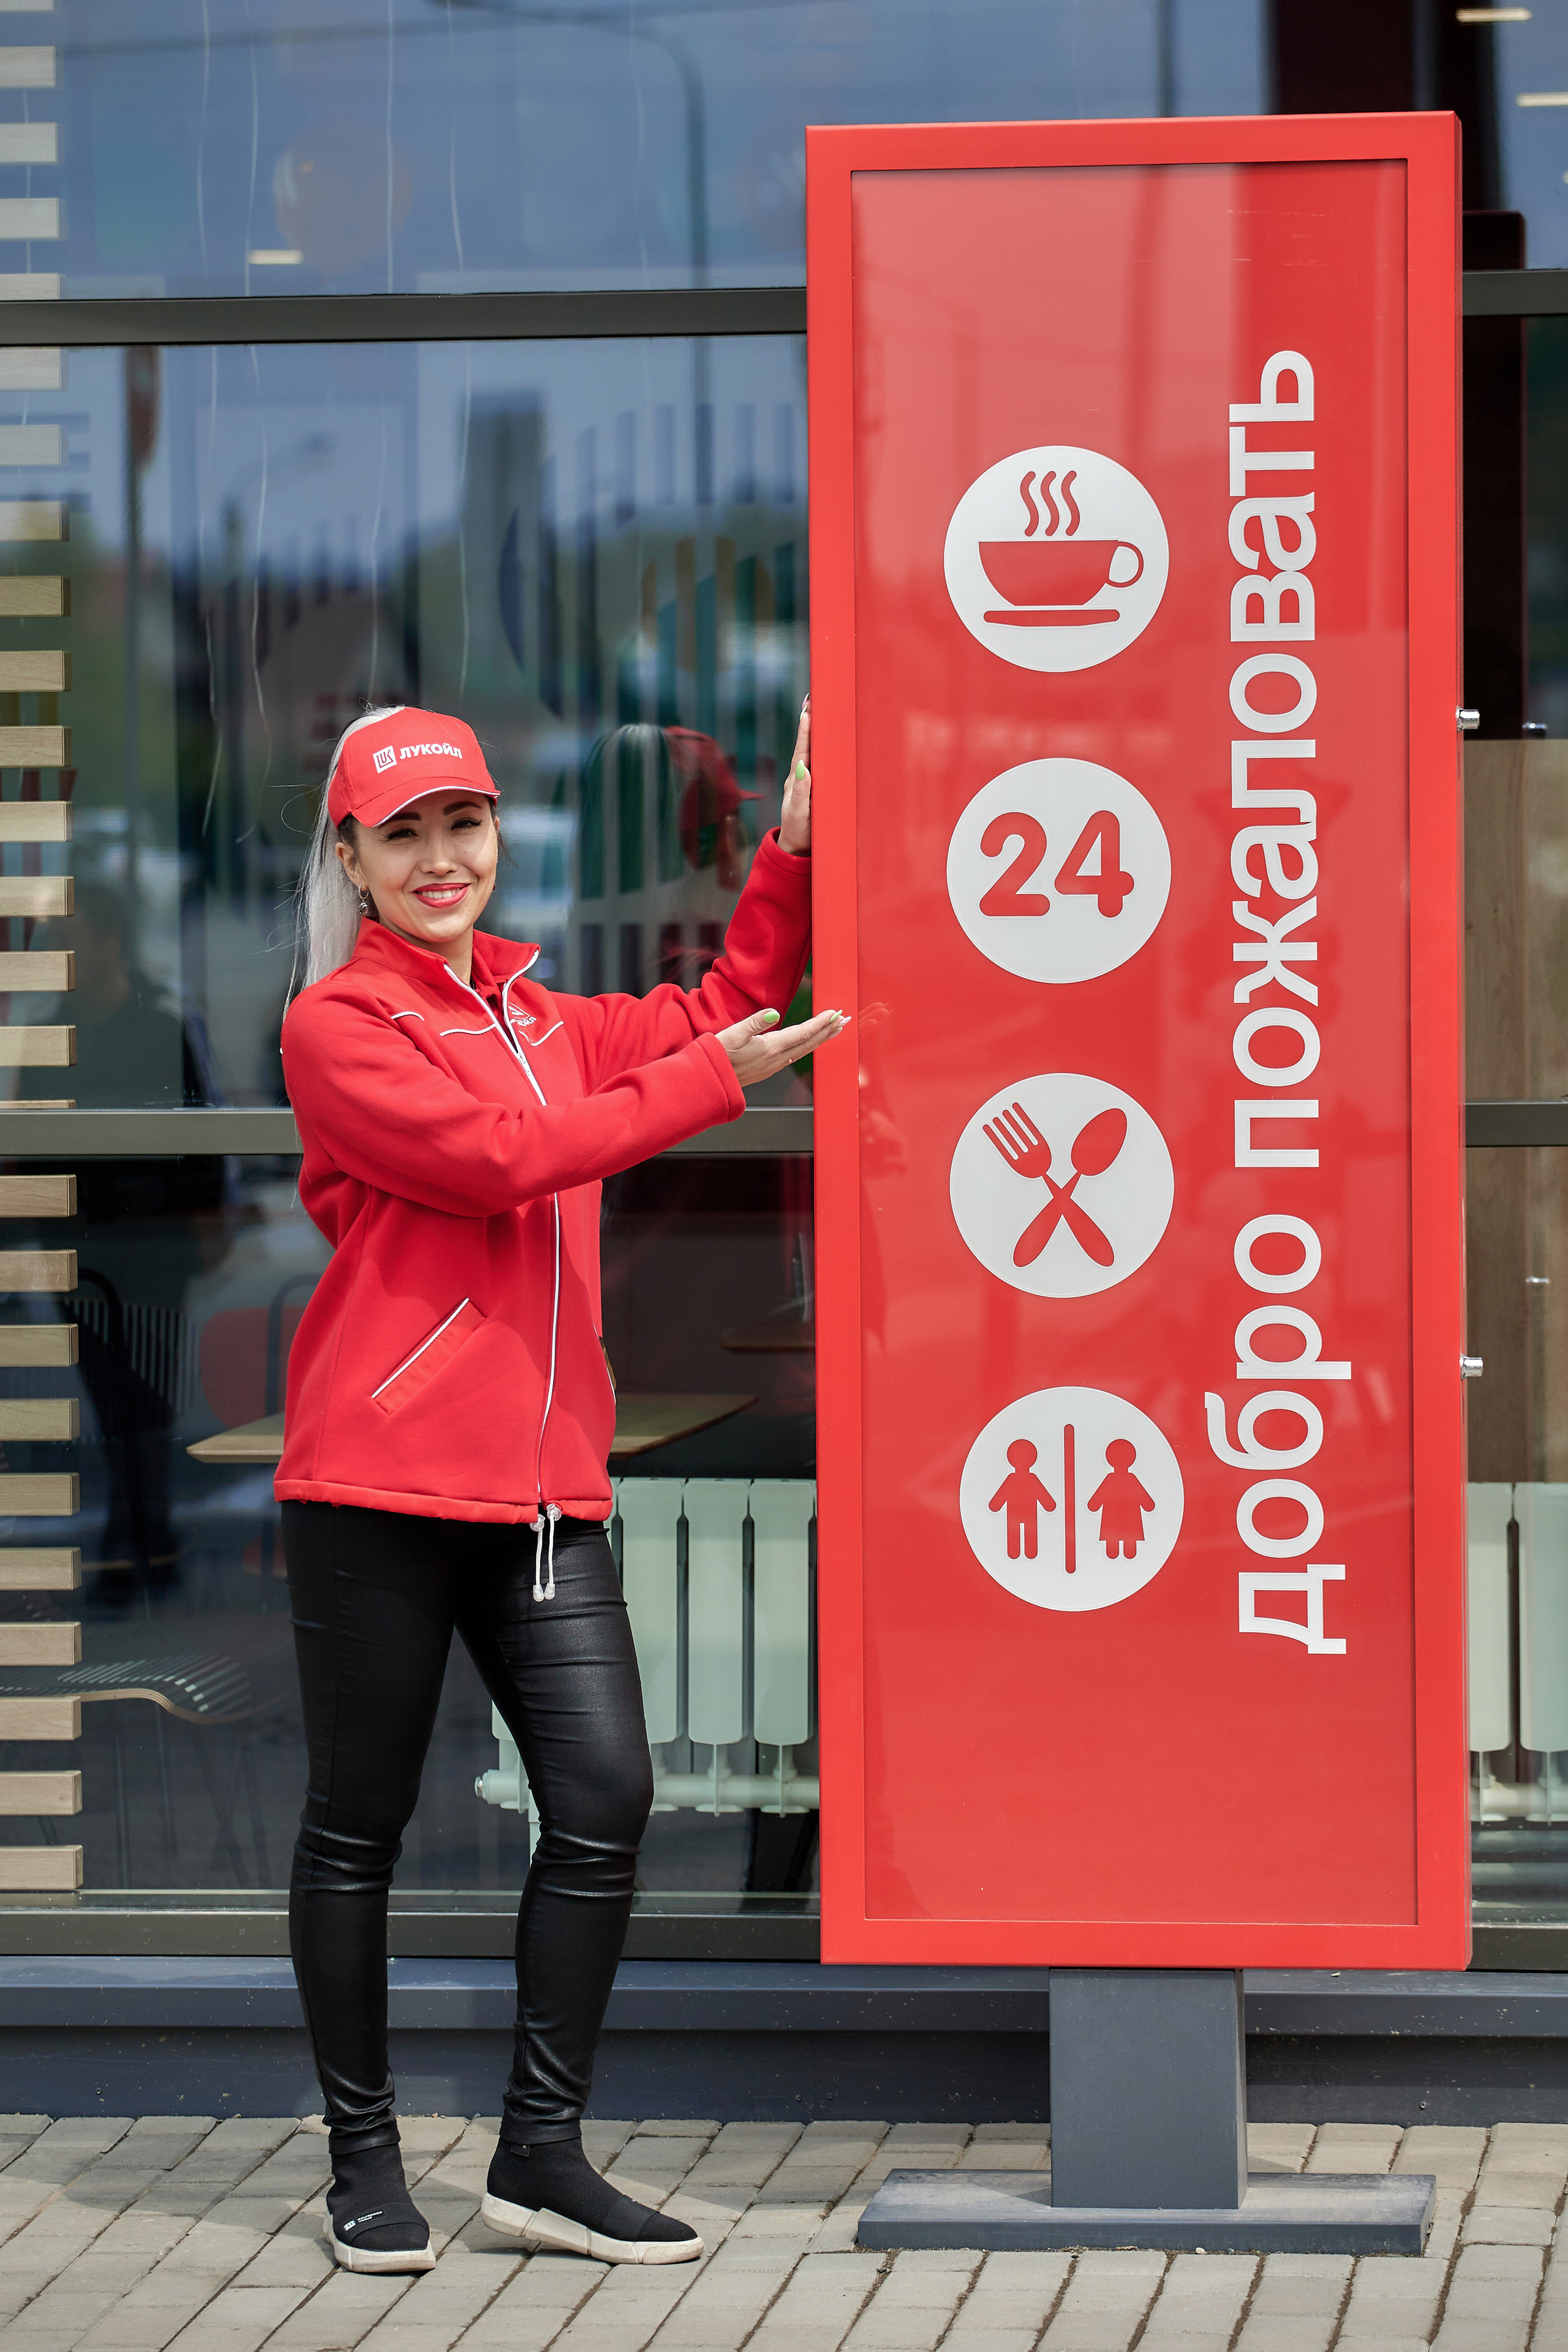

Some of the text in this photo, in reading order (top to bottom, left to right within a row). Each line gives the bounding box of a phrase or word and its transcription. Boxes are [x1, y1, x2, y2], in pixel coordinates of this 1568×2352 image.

[399, 742, 463, 760] ЛУКОЙЛ
[979, 810, 1134, 918] 24
[1204, 350, 1352, 1654] добро пожаловать
